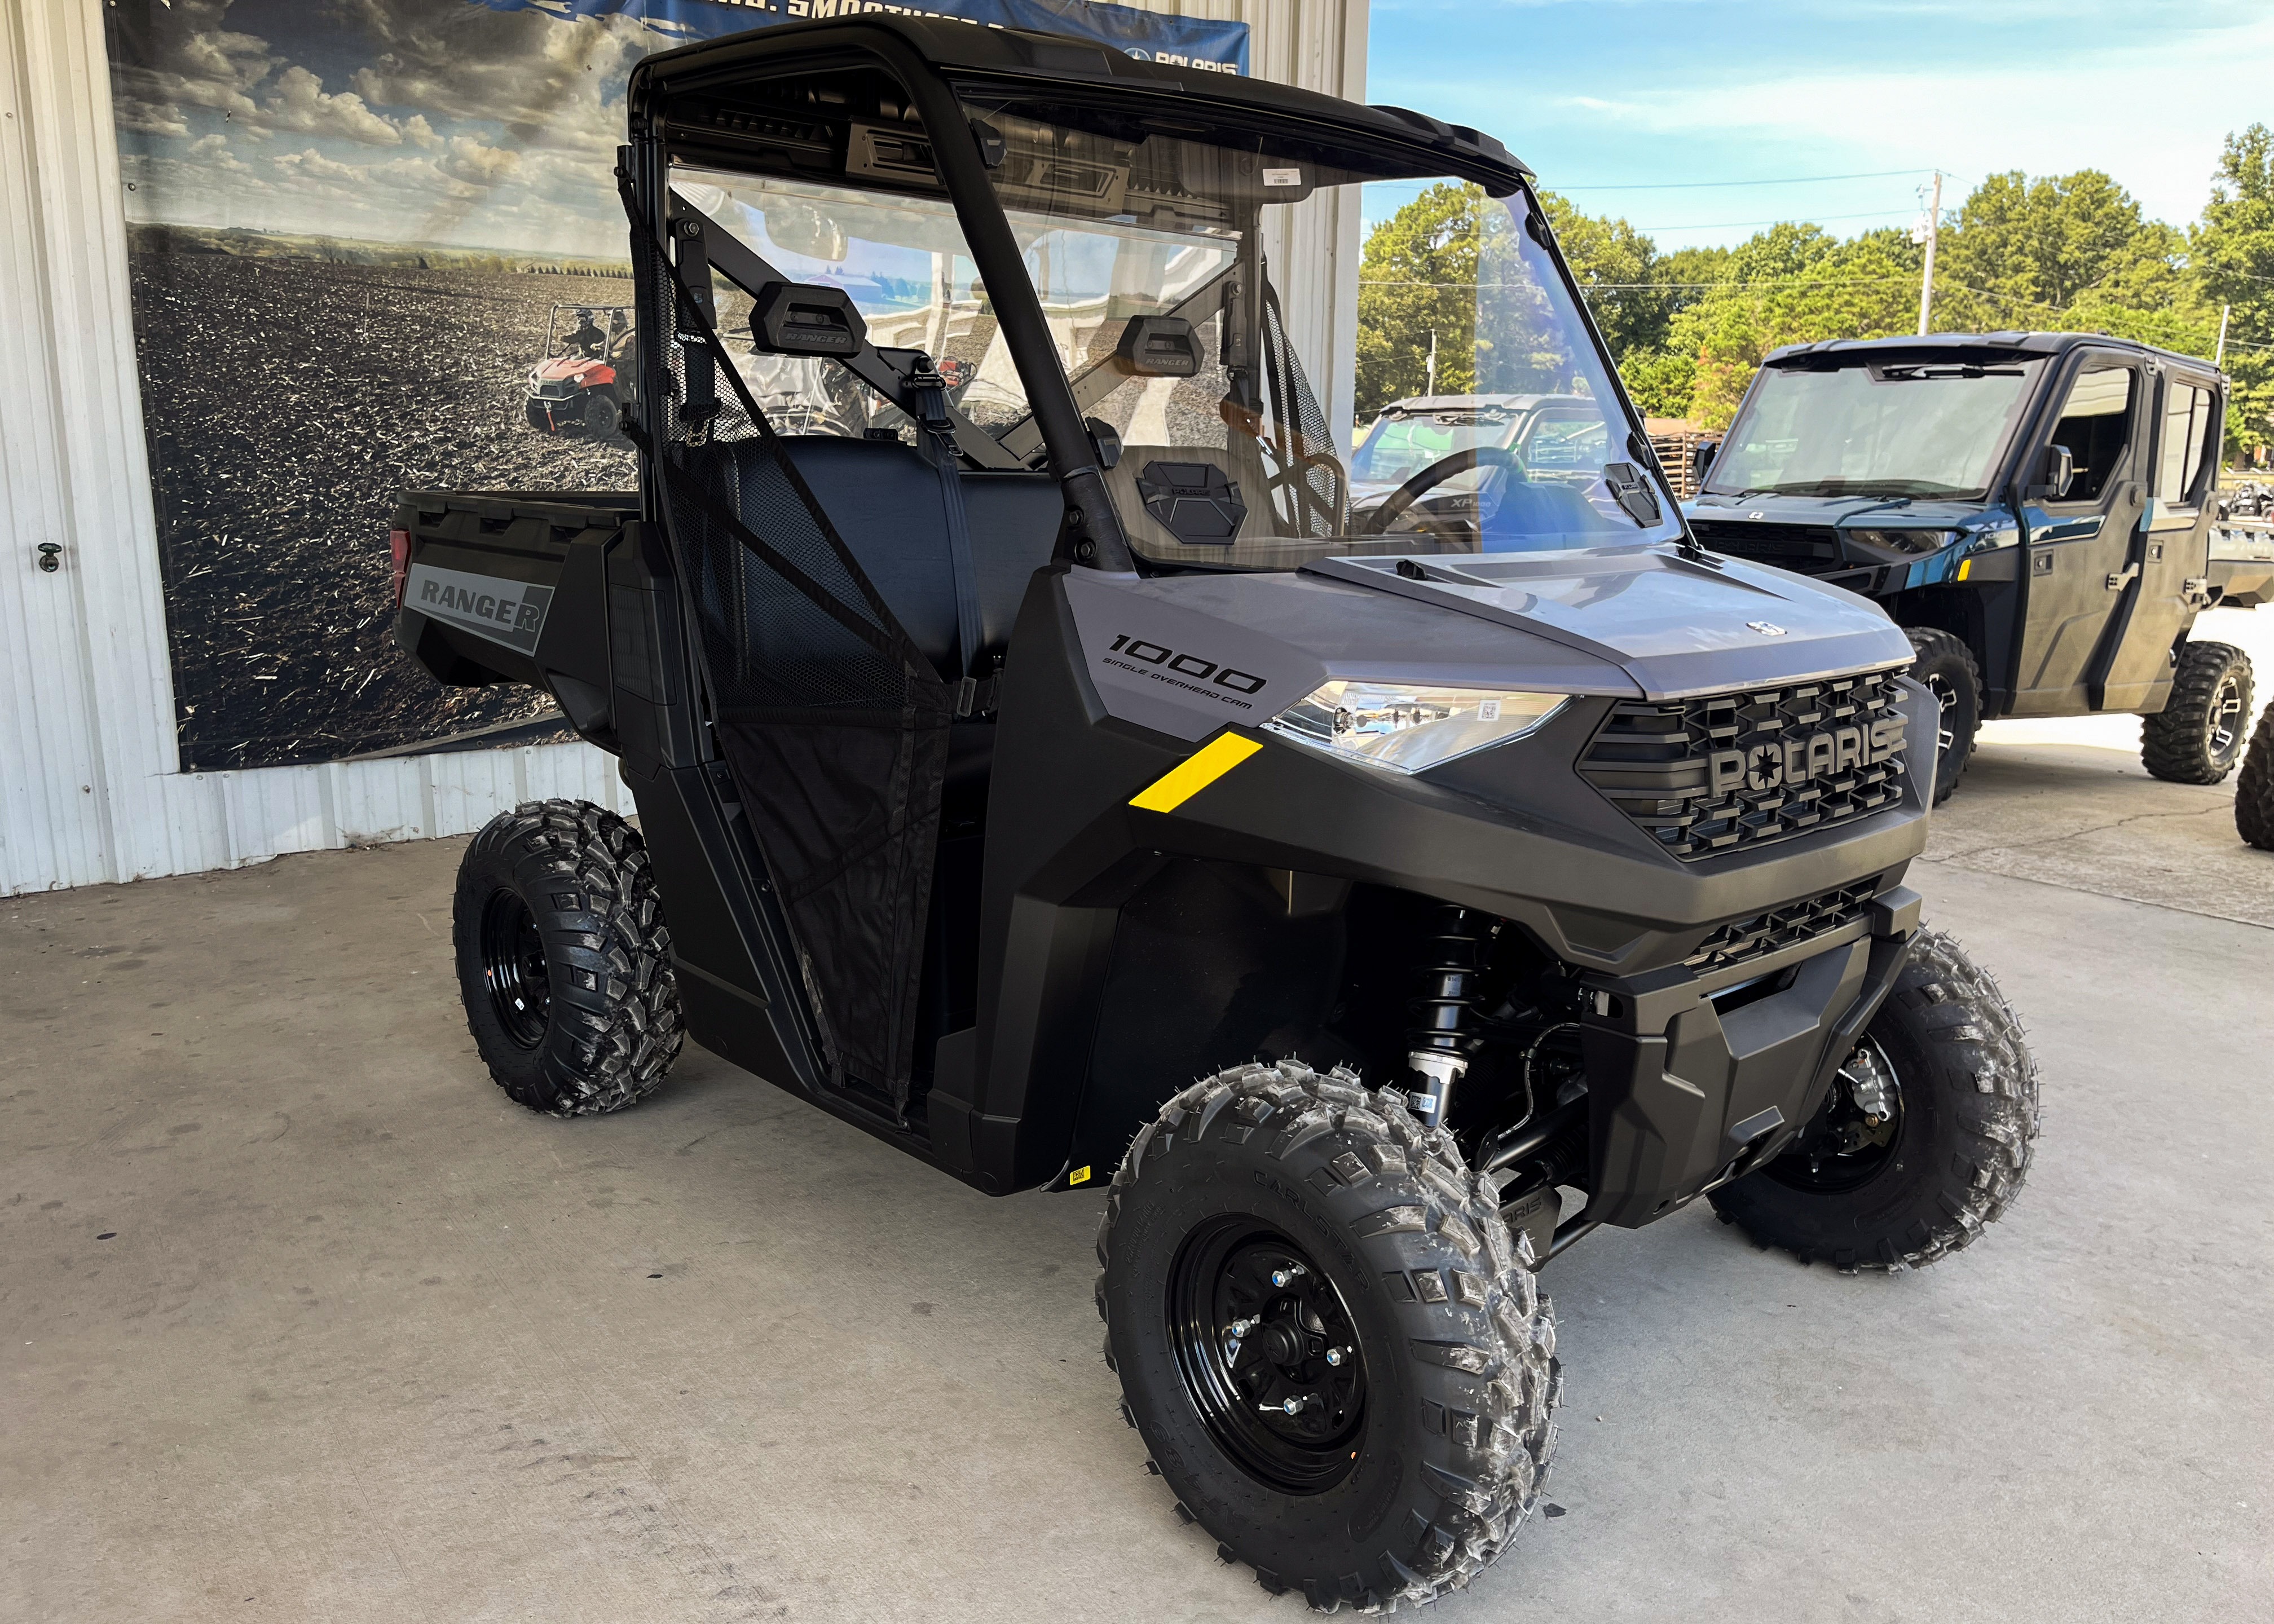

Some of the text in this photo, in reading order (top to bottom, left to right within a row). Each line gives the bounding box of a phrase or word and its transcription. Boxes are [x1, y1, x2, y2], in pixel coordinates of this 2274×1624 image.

[785, 333, 847, 345] RANGER
[1451, 498, 1473, 507] XP
[421, 580, 540, 633] RANGER
[1102, 657, 1253, 710] SINGLE OVERHEAD CAM
[1109, 634, 1267, 695] 1000
[1709, 720, 1893, 798] POLARIS
[1253, 1170, 1370, 1292] CARLSTAR
[1502, 1196, 1542, 1223] ARIS
